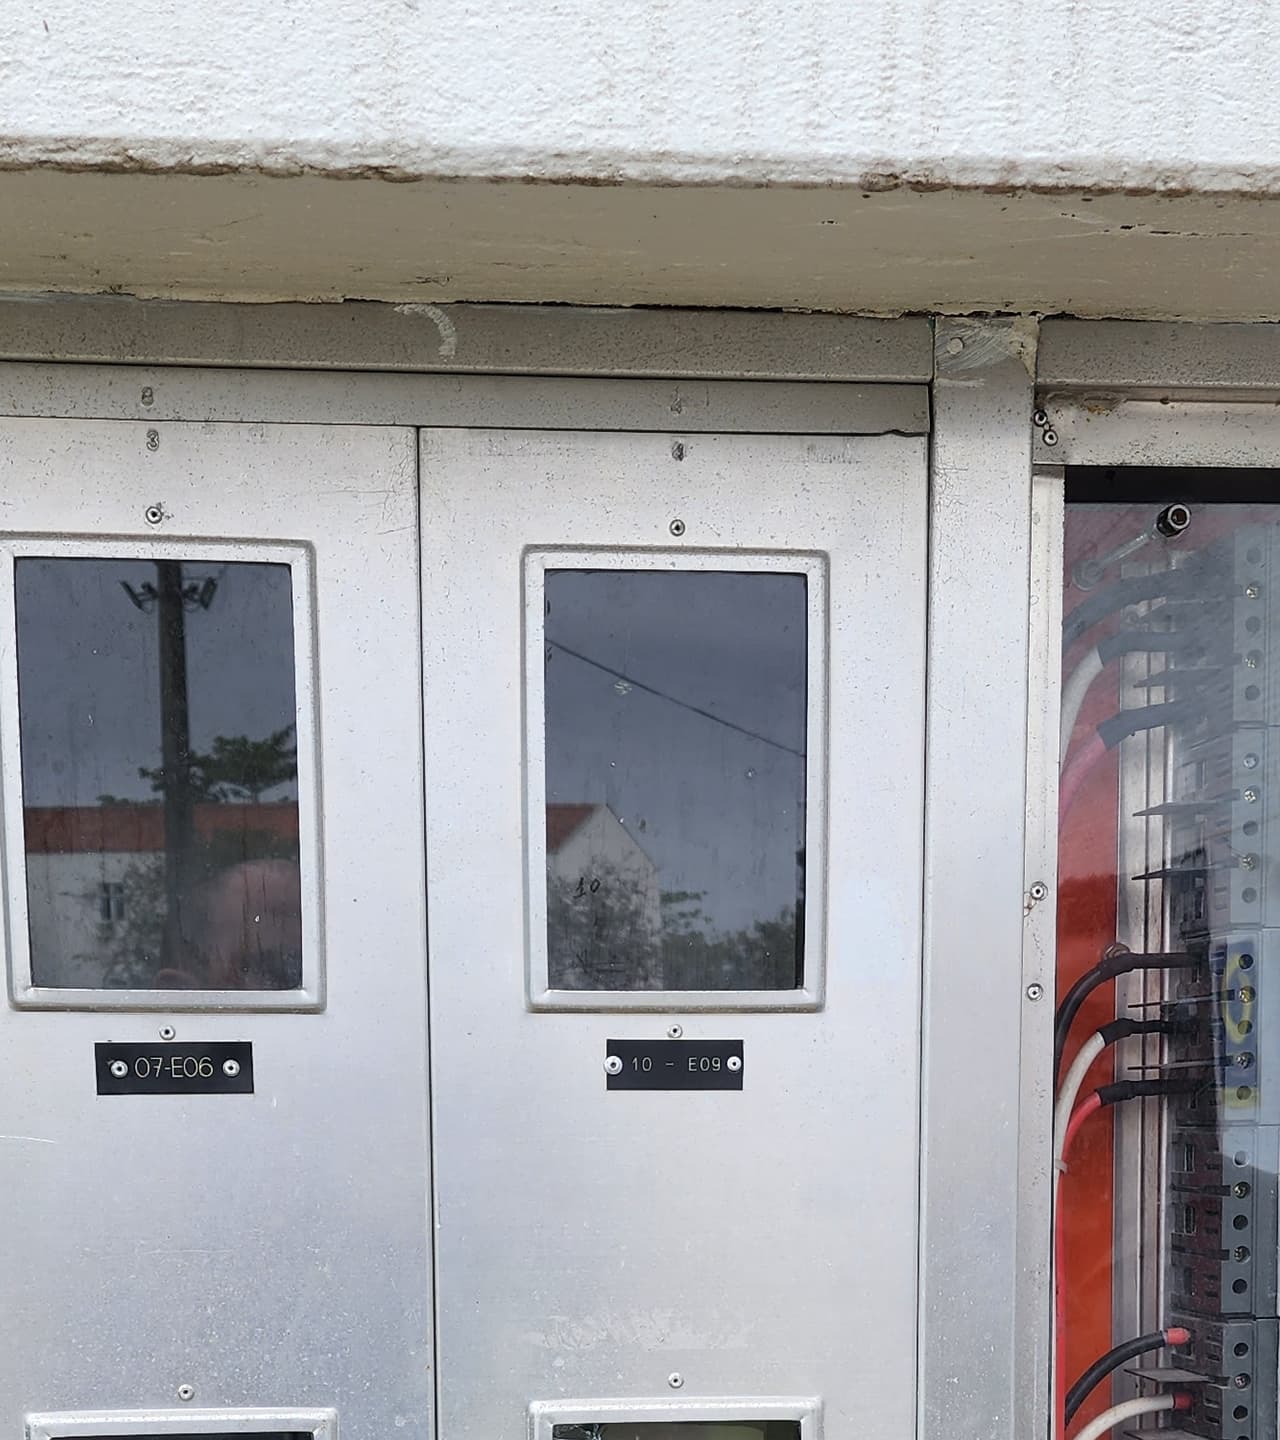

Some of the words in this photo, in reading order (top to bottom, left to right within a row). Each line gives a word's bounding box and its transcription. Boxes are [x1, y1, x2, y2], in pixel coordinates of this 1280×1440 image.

[134, 1057, 214, 1079] 07-E06
[631, 1057, 652, 1073] 10
[688, 1057, 721, 1073] E09
